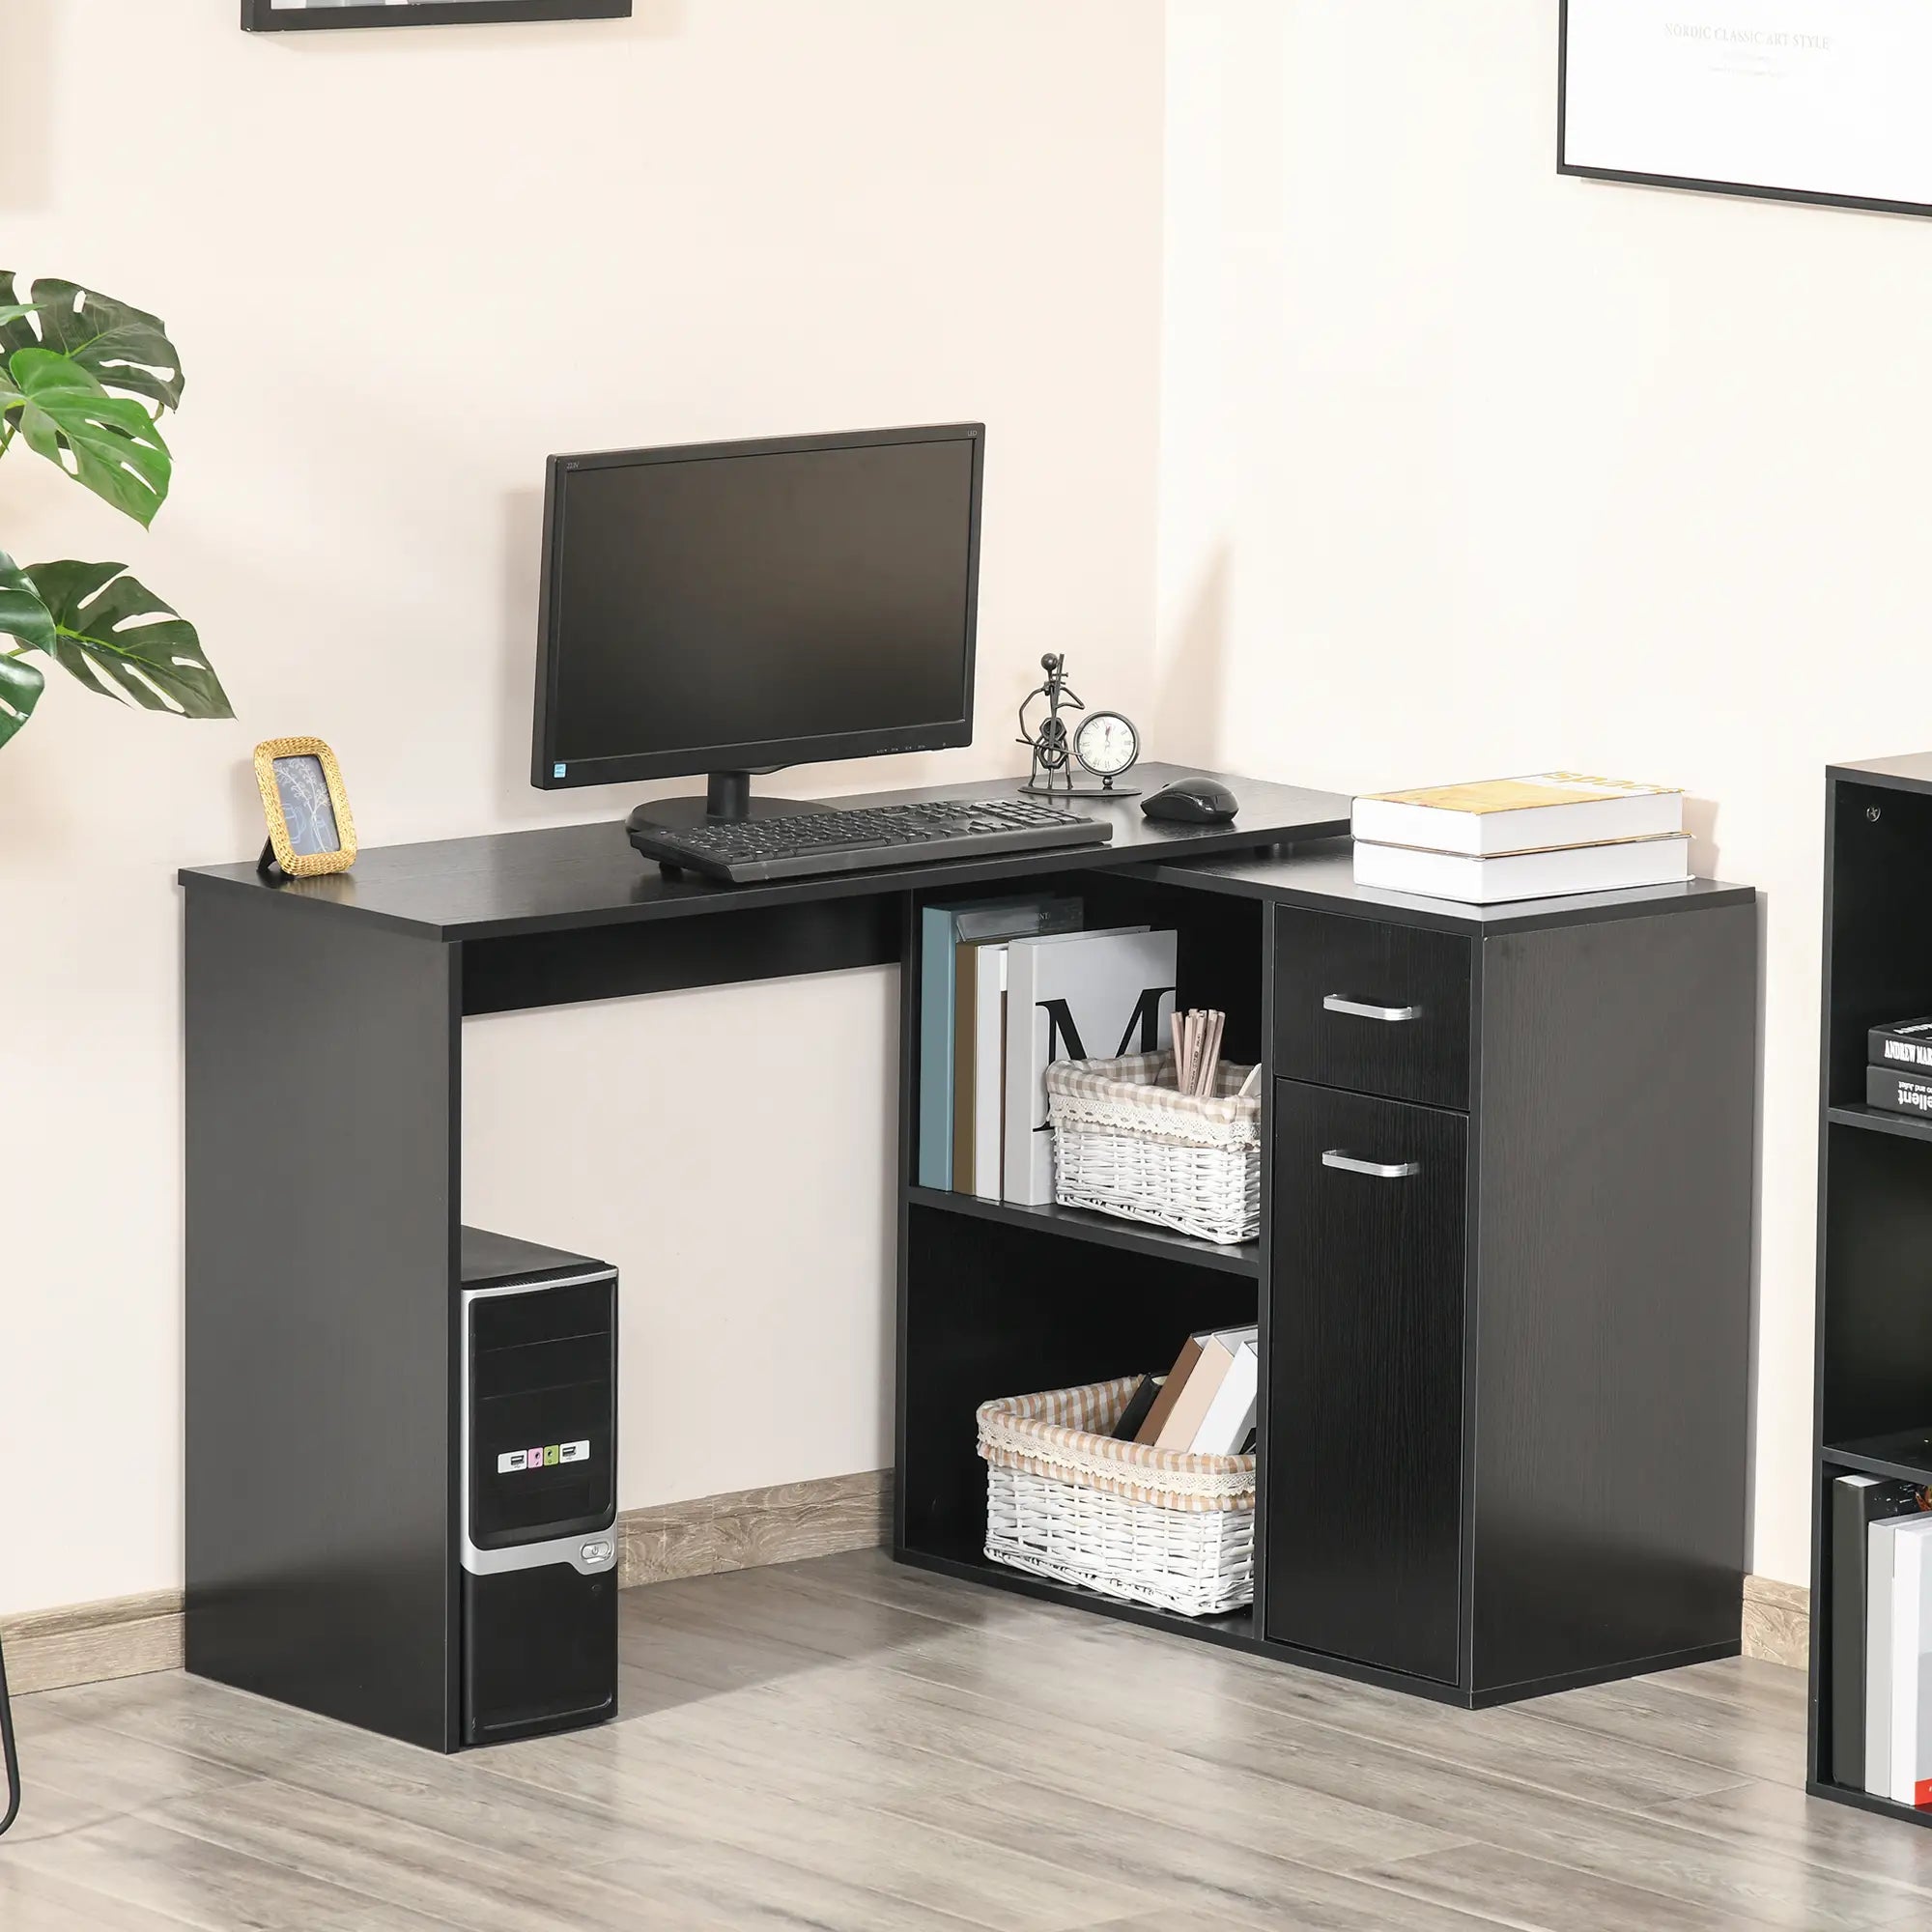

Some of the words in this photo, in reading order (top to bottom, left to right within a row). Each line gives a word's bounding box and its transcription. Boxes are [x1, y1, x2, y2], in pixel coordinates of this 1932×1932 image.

[1664, 22, 1712, 40] NORDIC
[1714, 27, 1764, 44] CLASSIC
[1766, 32, 1789, 46] ART
[1792, 34, 1831, 50] STYLE
[1885, 1039, 1916, 1063] ANDREW
